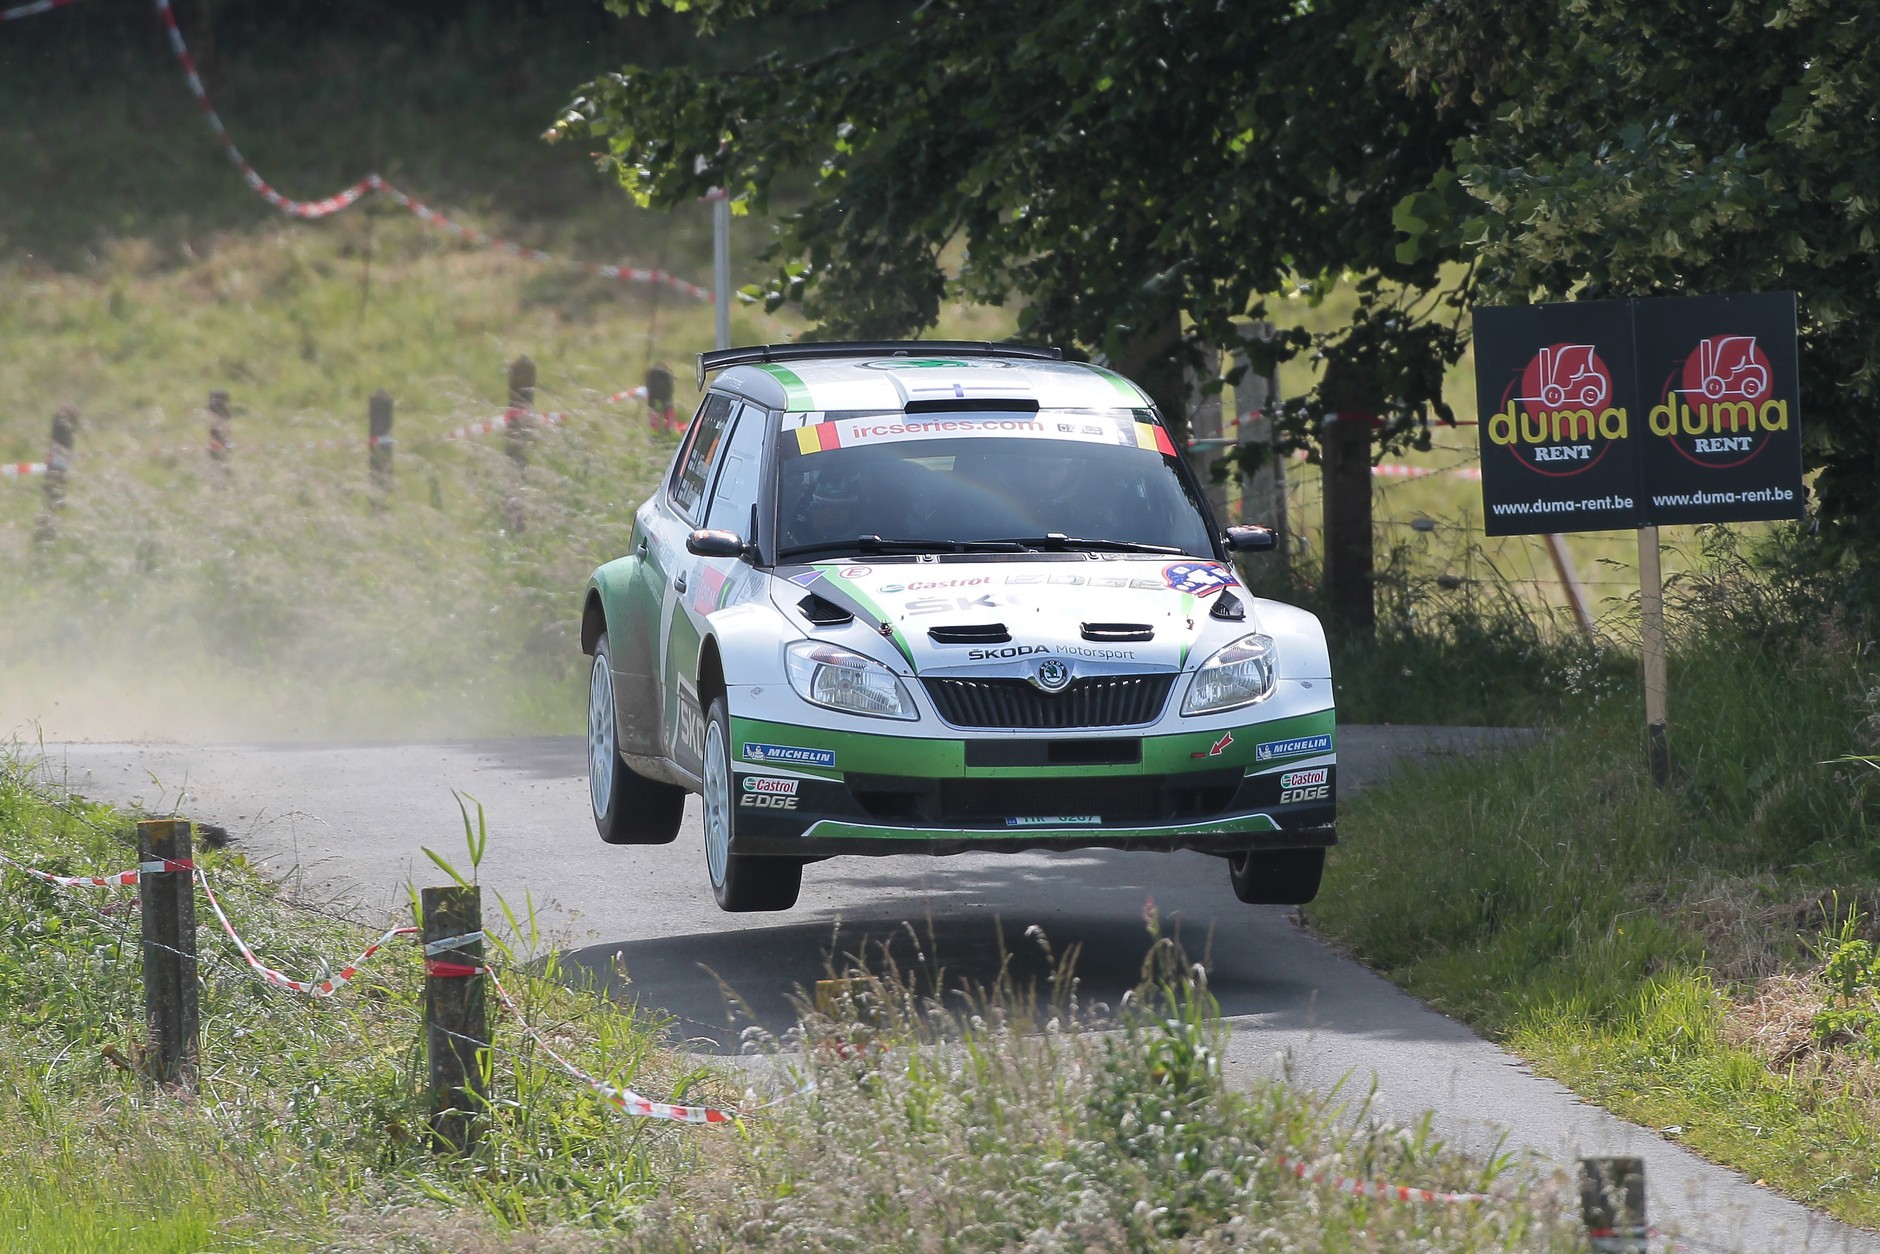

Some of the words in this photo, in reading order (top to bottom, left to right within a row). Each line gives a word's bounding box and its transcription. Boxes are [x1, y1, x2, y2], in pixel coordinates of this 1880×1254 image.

[1648, 391, 1788, 437] duma
[852, 418, 1045, 439] ircseries.com
[1488, 399, 1628, 446] duma
[1534, 445, 1592, 461] RENT
[1695, 437, 1753, 453] RENT
[1653, 487, 1793, 507] www.duma-rent.be
[1493, 497, 1634, 515] www.duma-rent.be
[907, 576, 991, 590] Castrol
[968, 645, 1051, 660] ŠKODA
[1056, 645, 1135, 660] Motorsport
[1273, 738, 1327, 753] MICHELIN
[767, 747, 831, 762] MICHELIN
[756, 779, 796, 793] Castrol
[1291, 772, 1325, 786] Castrol
[740, 794, 800, 810] EDGE
[1280, 785, 1331, 804] EDGE
